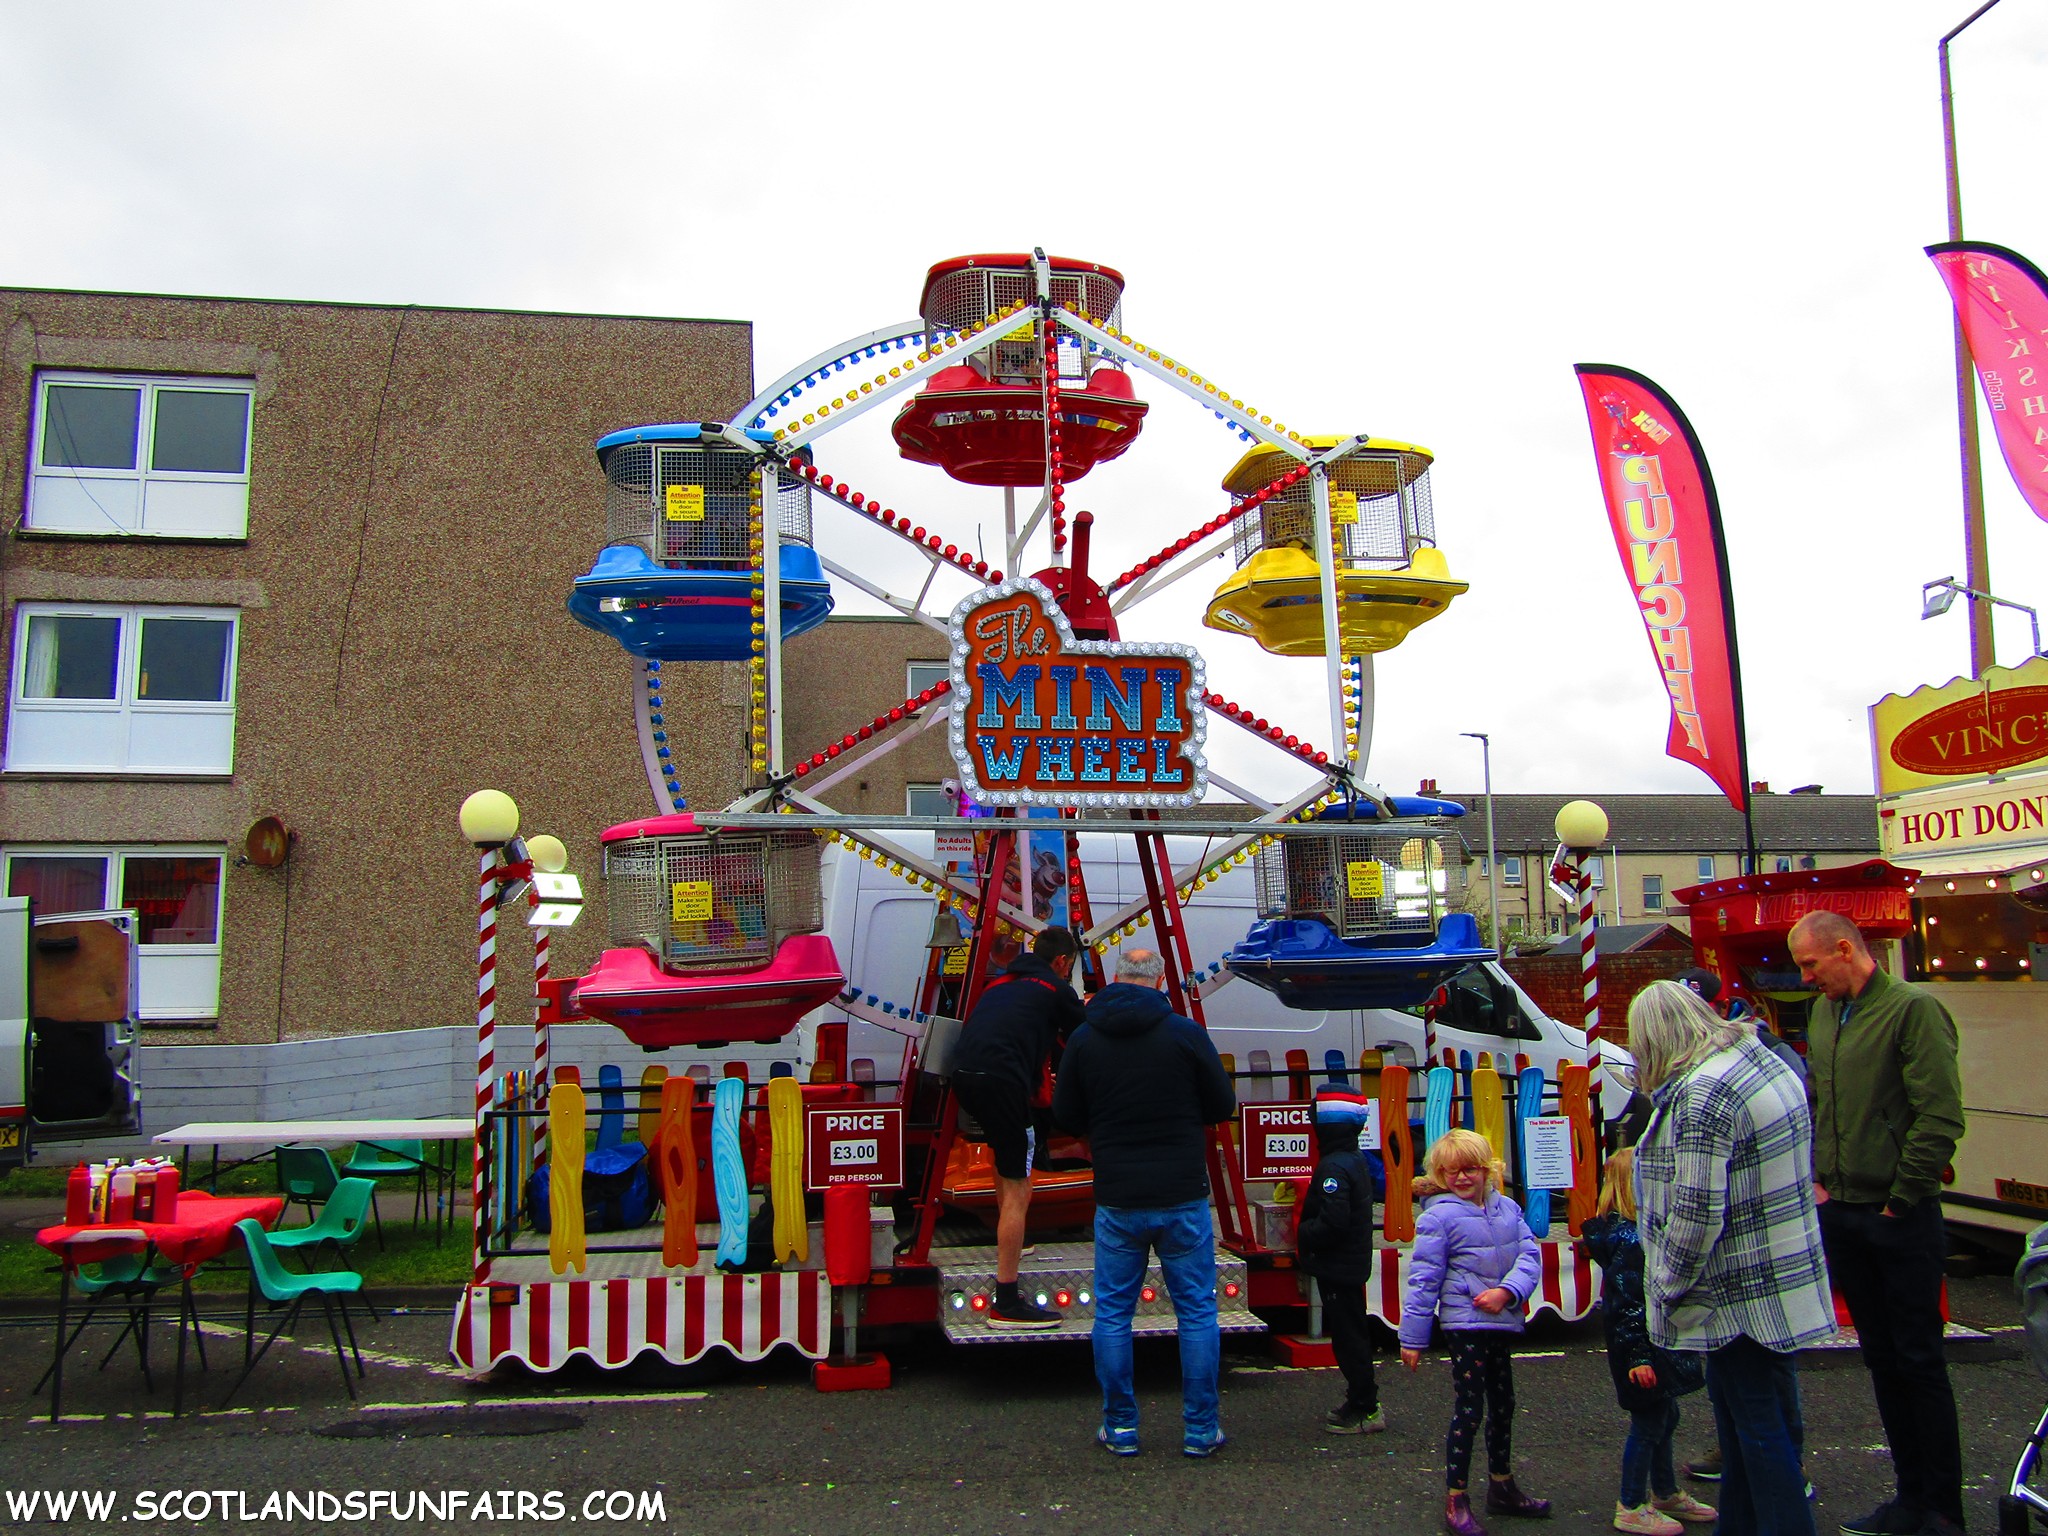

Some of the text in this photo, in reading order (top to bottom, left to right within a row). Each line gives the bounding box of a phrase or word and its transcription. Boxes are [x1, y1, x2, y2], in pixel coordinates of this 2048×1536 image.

[975, 604, 1051, 663] The
[977, 663, 1182, 732] MINI
[1967, 703, 2007, 719] CAFE
[977, 735, 1182, 783] WHEEL
[1901, 795, 2048, 845] HOT DON
[1758, 891, 1911, 924] KICKPUNC
[826, 1115, 885, 1131] PRICE
[1259, 1110, 1312, 1126] PRICE
[833, 1145, 875, 1159] £3.00
[1268, 1139, 1307, 1153] £3.00
[847, 1173, 883, 1182] PERSON
[1262, 1165, 1312, 1174] PER PERSON
